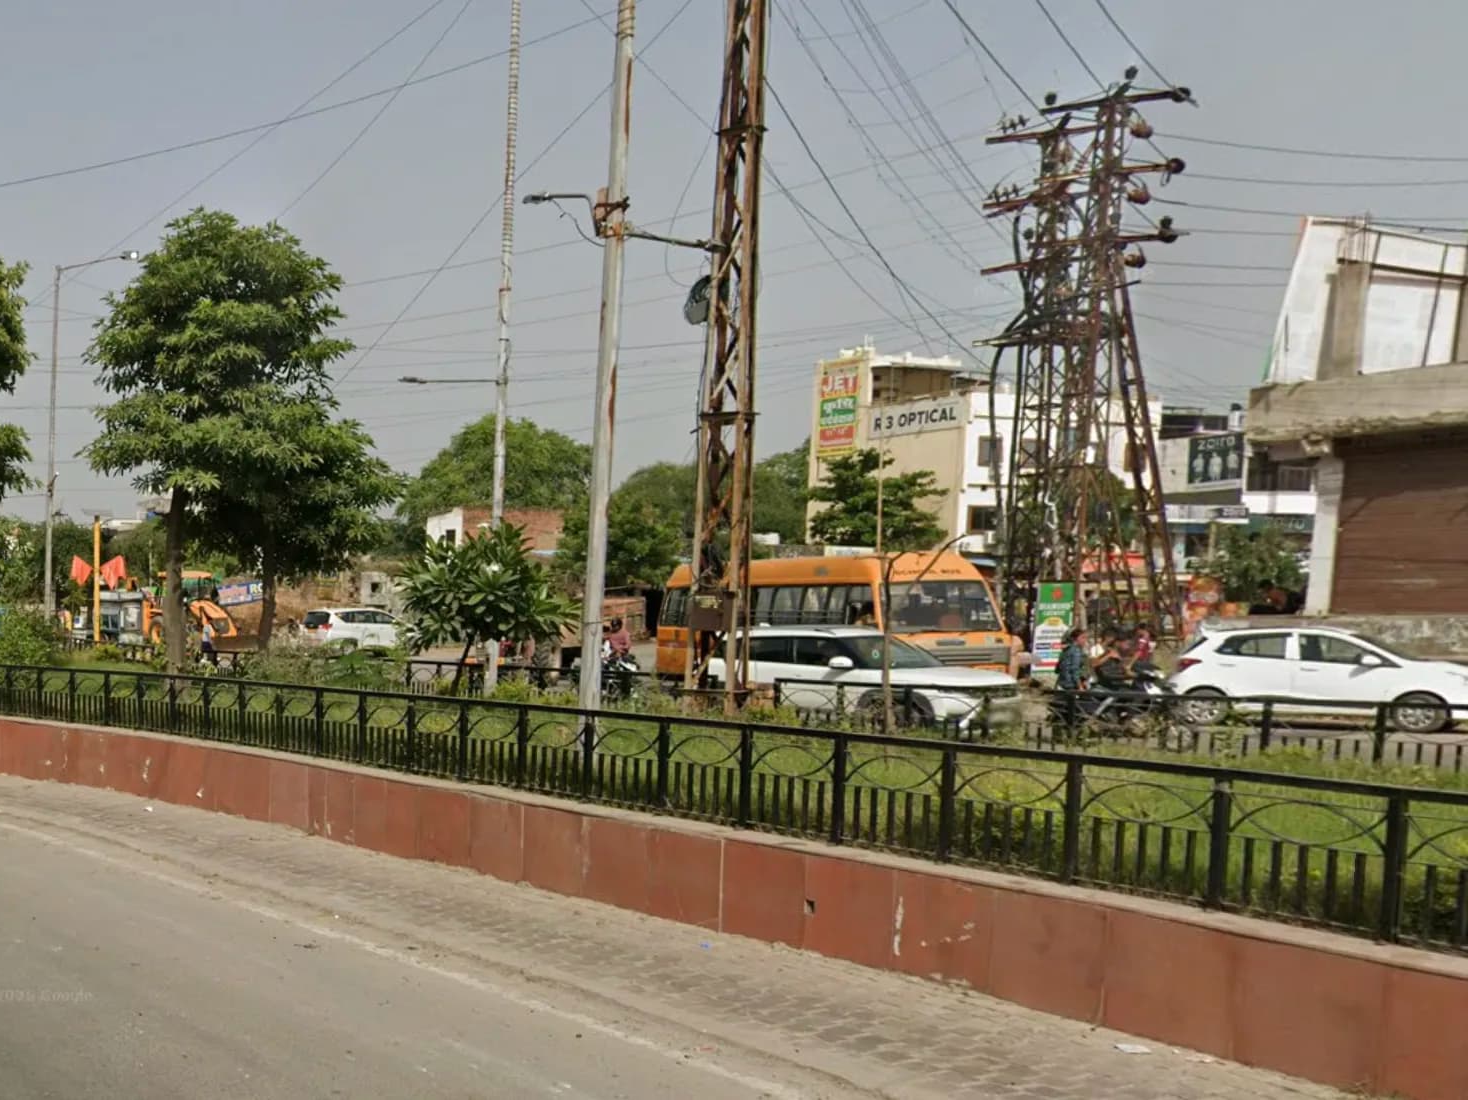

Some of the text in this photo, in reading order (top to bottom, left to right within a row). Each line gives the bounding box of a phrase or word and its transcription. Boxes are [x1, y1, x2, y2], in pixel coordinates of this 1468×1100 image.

[822, 374, 857, 392] JET
[874, 406, 957, 431] R 3 OPTICAL
